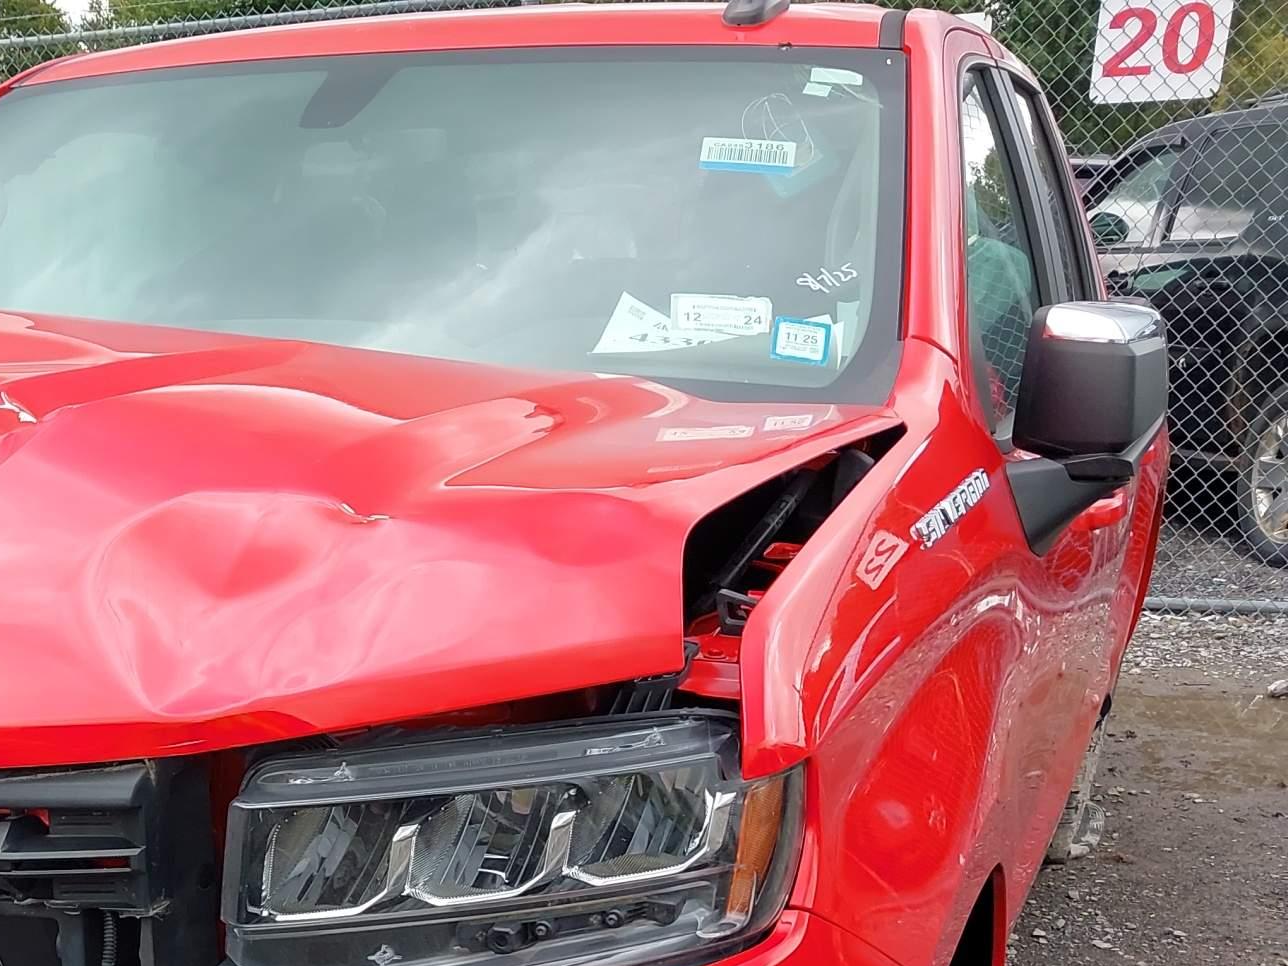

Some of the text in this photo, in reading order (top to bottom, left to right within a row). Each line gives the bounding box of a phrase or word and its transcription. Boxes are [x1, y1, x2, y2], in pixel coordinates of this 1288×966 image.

[1102, 2, 1216, 78] 20
[684, 311, 762, 325] 12 24
[785, 331, 818, 344] 11 25
